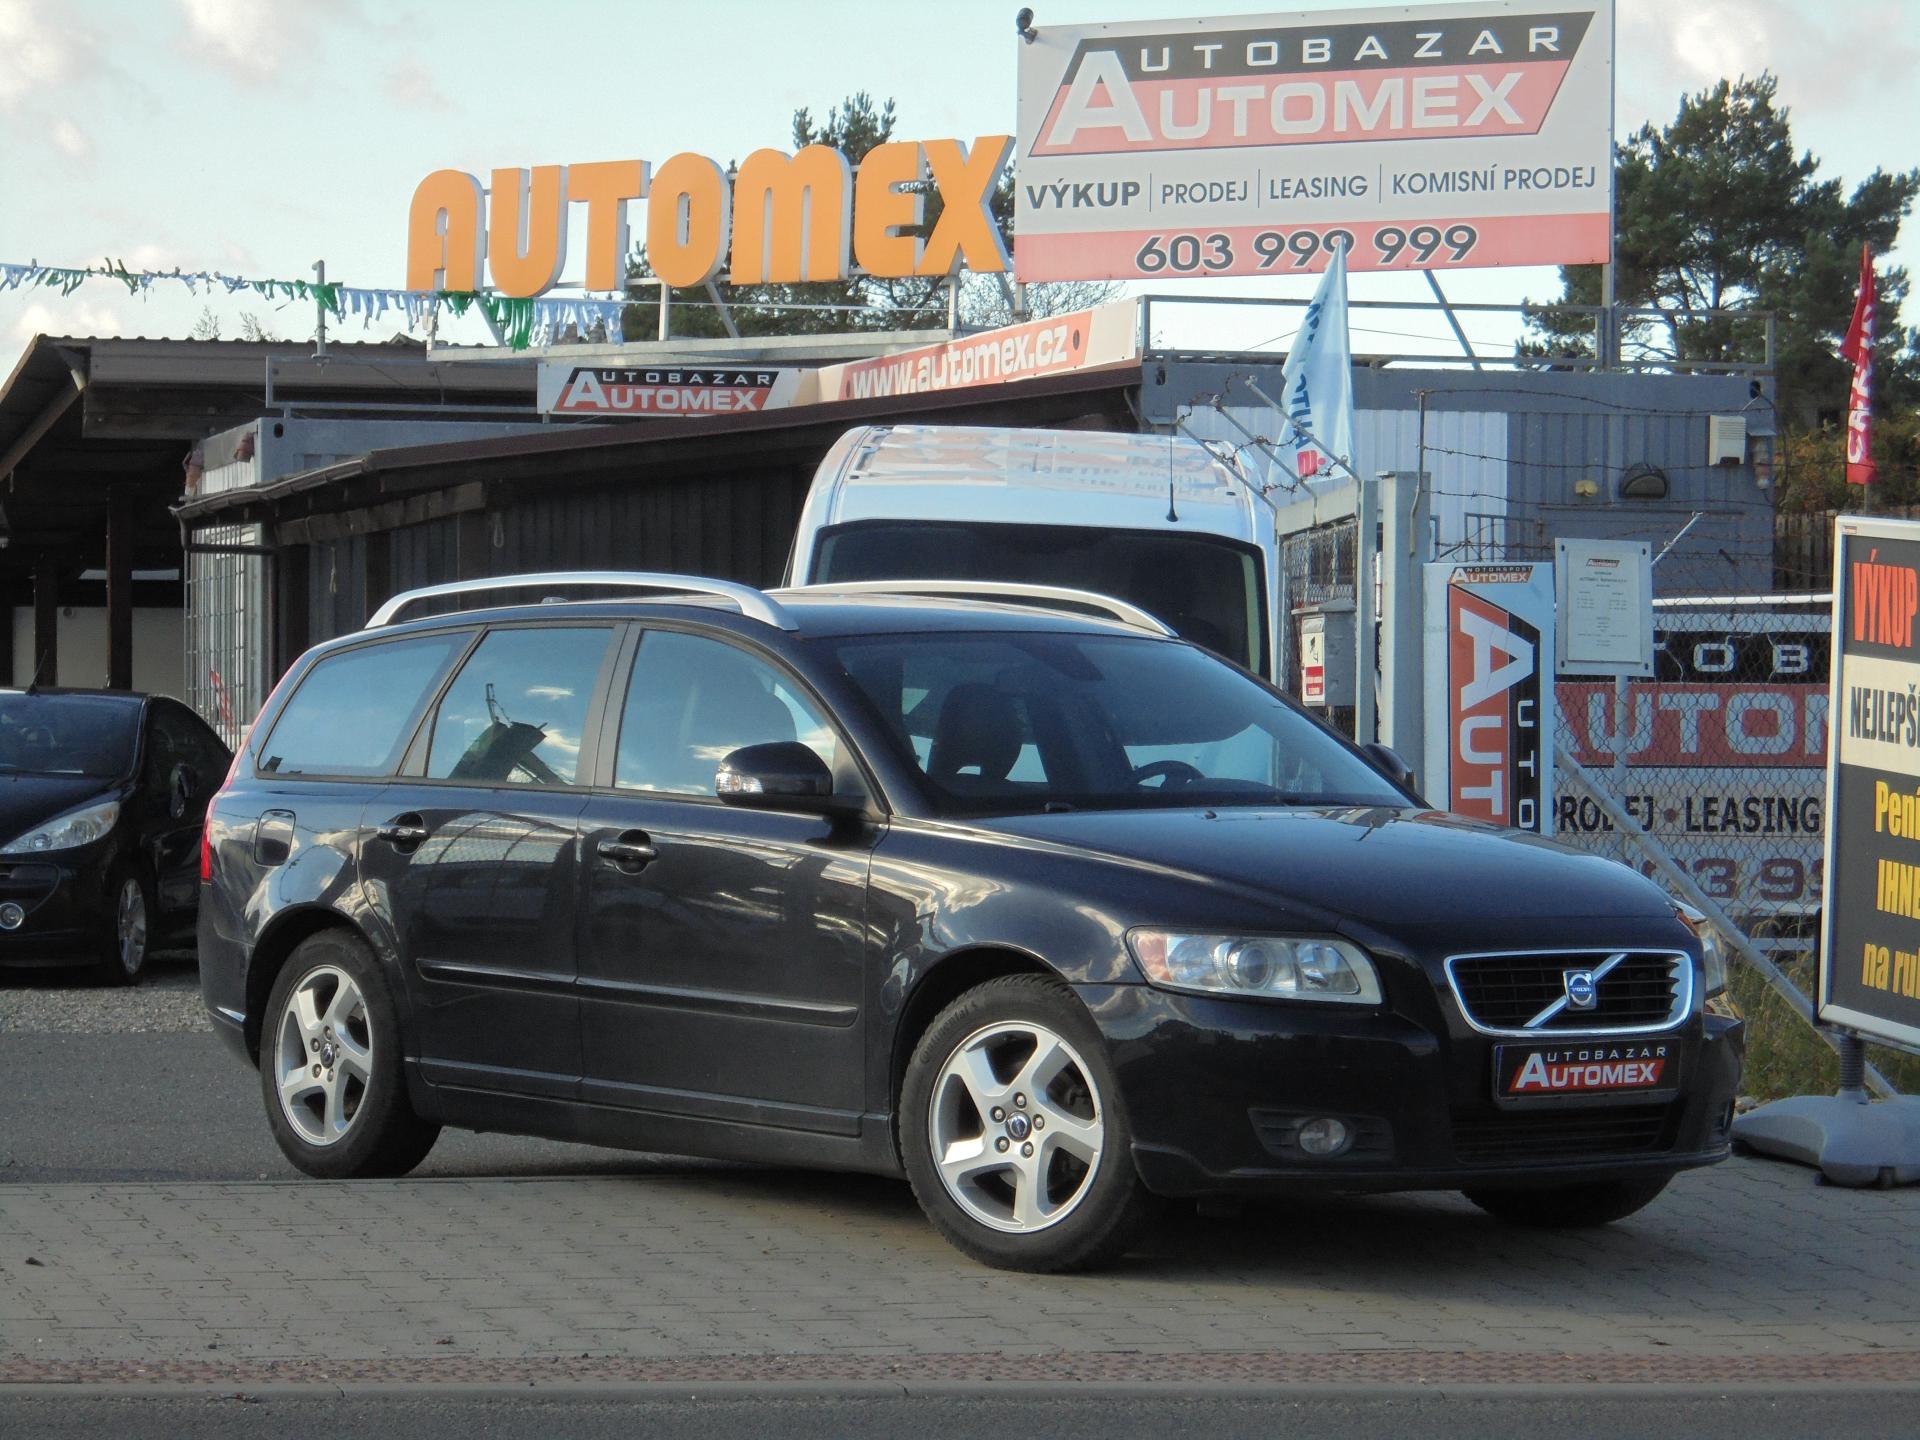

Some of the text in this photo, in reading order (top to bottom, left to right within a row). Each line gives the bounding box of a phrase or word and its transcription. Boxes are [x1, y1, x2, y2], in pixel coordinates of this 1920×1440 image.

[1046, 50, 1524, 146] AUTOMEX
[1026, 163, 1595, 210] VÝKUP PRODEJ LEASING KOMISNÍ PRODEJ
[406, 135, 1016, 297] AUTOMEX
[1136, 223, 1478, 273] 603 999 999
[853, 324, 1068, 399] www.automex.cz
[564, 371, 757, 410] AUTOMEX
[1450, 567, 1527, 583] AUTOMEX
[1853, 548, 1917, 648] VÝKUP
[1685, 796, 1821, 833] LEASING
[1862, 943, 1889, 991] na
[1515, 1053, 1656, 1088] AUTOMEX
